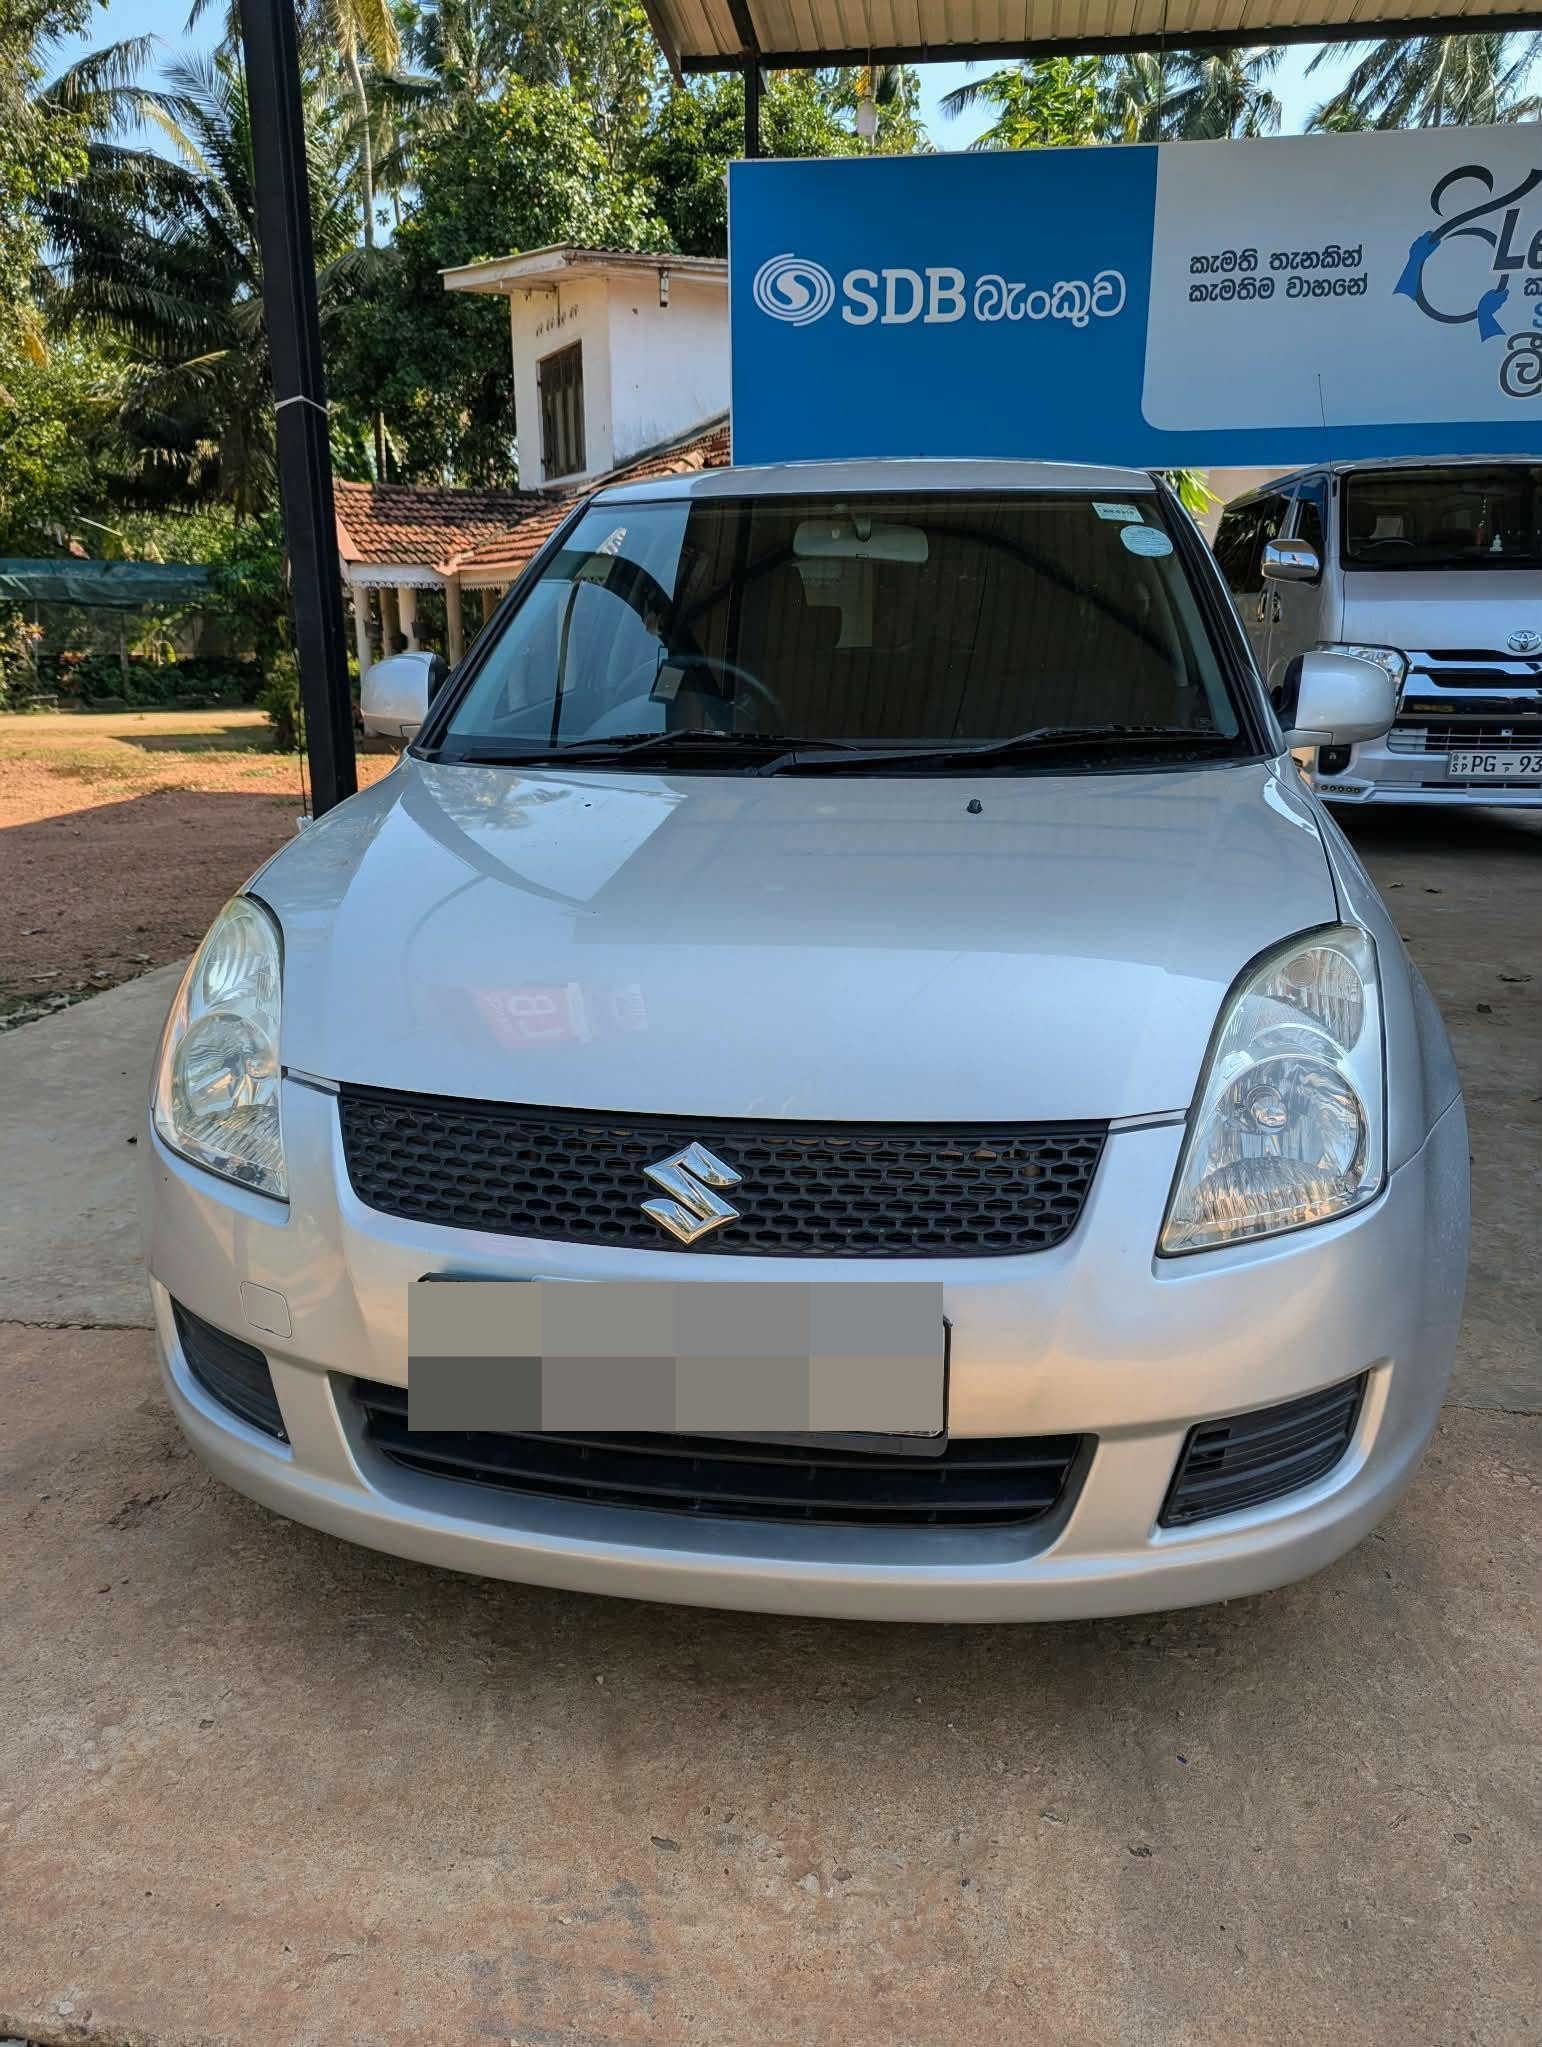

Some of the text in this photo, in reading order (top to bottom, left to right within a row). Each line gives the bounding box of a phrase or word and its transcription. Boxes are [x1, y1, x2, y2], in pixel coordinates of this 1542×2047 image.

[1189, 244, 1363, 274] කැමති තැනකින්
[842, 267, 1127, 328] SDB බැංකුව
[1188, 272, 1369, 302] කැමතිම වාහනේ
[1470, 755, 1497, 773] PG
